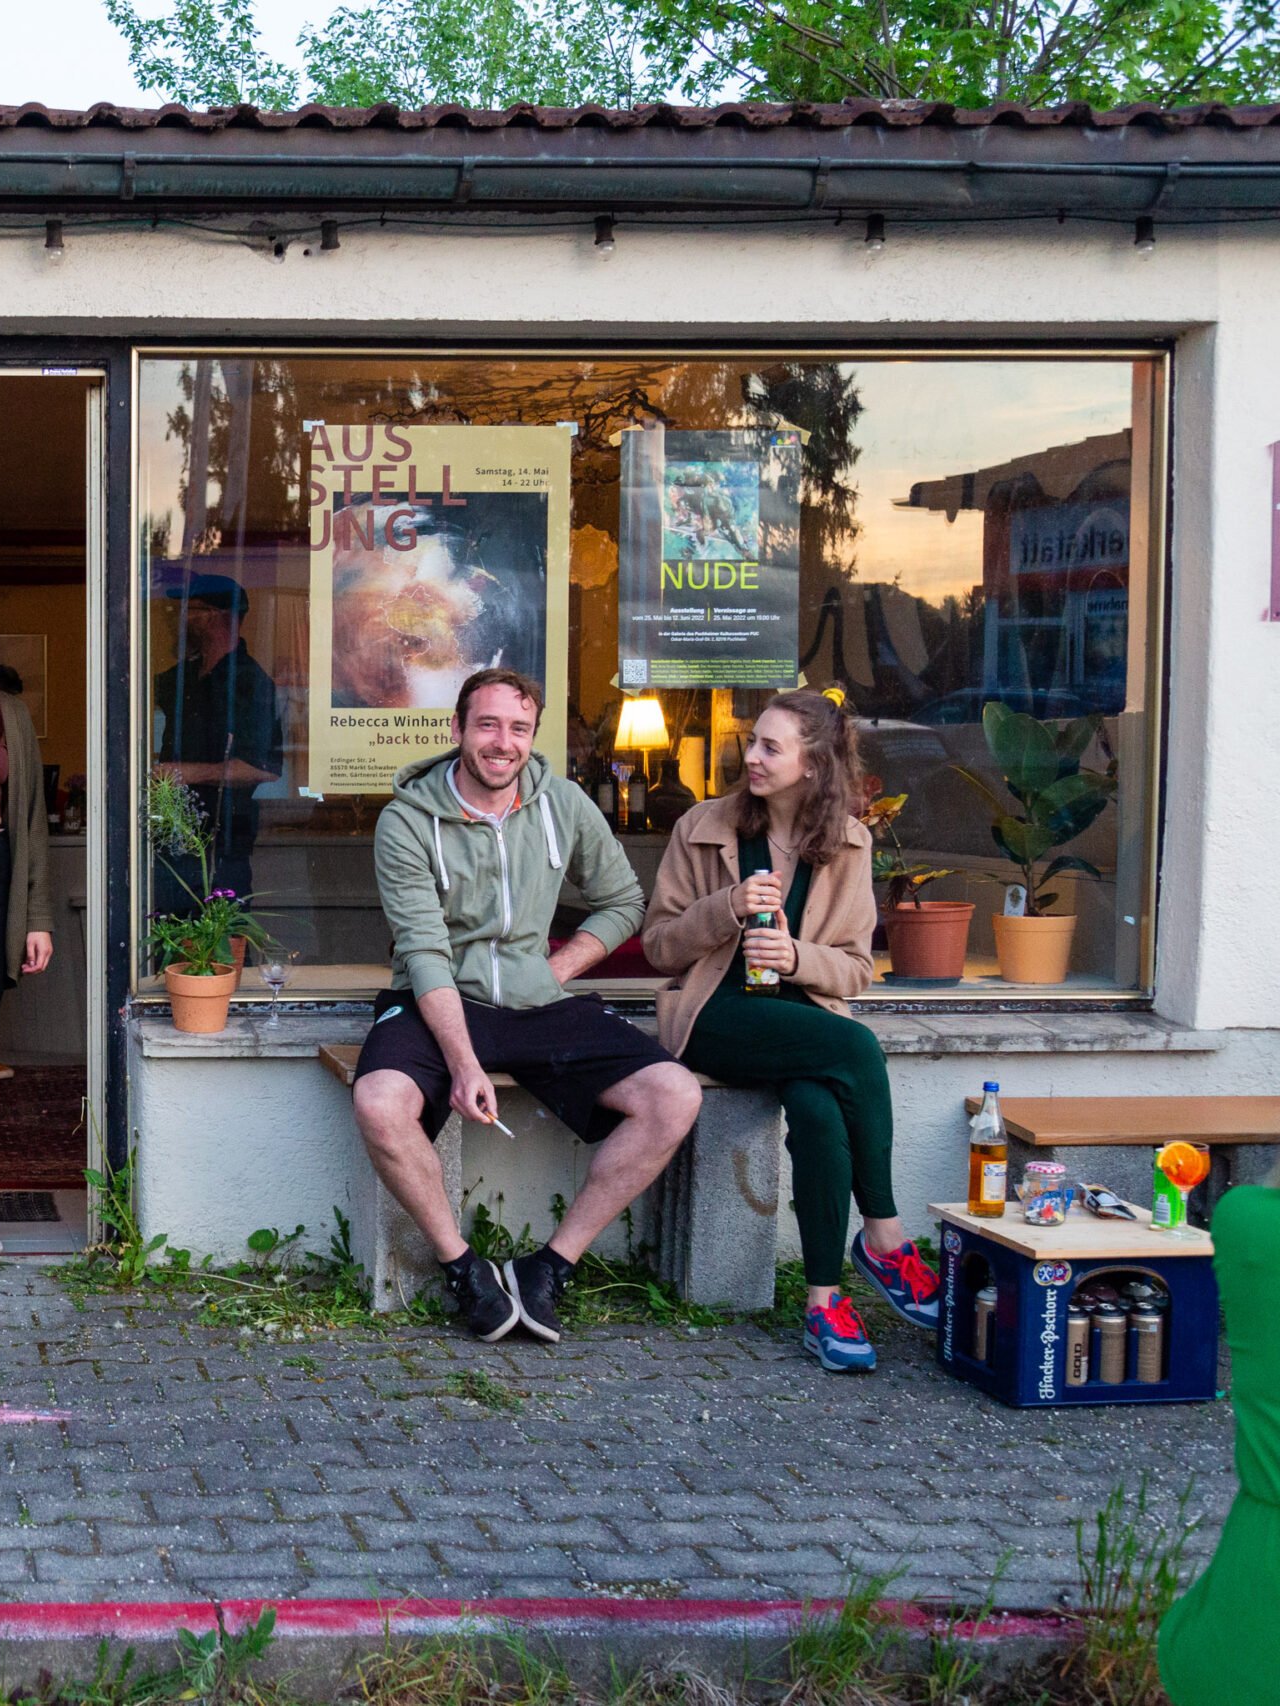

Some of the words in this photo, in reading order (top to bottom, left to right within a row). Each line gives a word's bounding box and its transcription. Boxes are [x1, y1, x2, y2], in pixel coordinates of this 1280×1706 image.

[310, 425, 412, 462] AUS
[310, 464, 467, 506] STELL
[475, 467, 516, 477] Samstag,
[533, 467, 549, 475] Mai
[310, 509, 419, 552] UNG
[661, 562, 759, 590] NUDE
[330, 715, 389, 728] Rebecca
[415, 734, 429, 745] to
[1039, 1289, 1060, 1399] Hacker-Pschorr
[1073, 1343, 1082, 1379] GOLD
